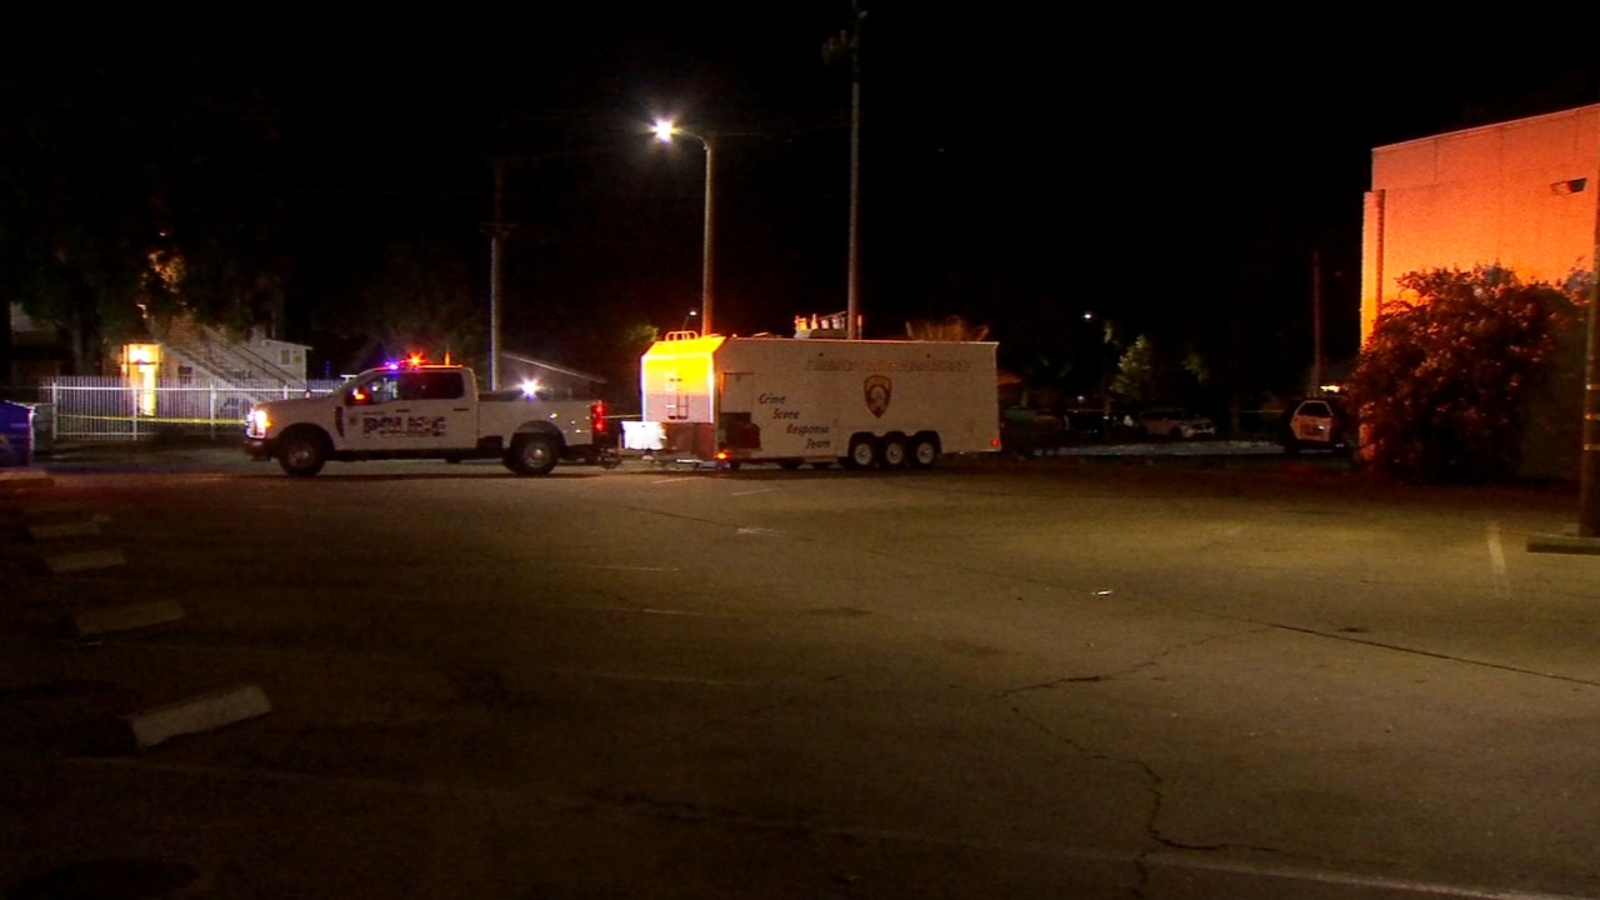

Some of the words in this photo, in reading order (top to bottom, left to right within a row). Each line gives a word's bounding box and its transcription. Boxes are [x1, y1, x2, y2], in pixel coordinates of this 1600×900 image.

[758, 393, 786, 405] Crime
[772, 408, 801, 420] Scene
[786, 423, 830, 436] Response
[805, 438, 831, 449] Team
